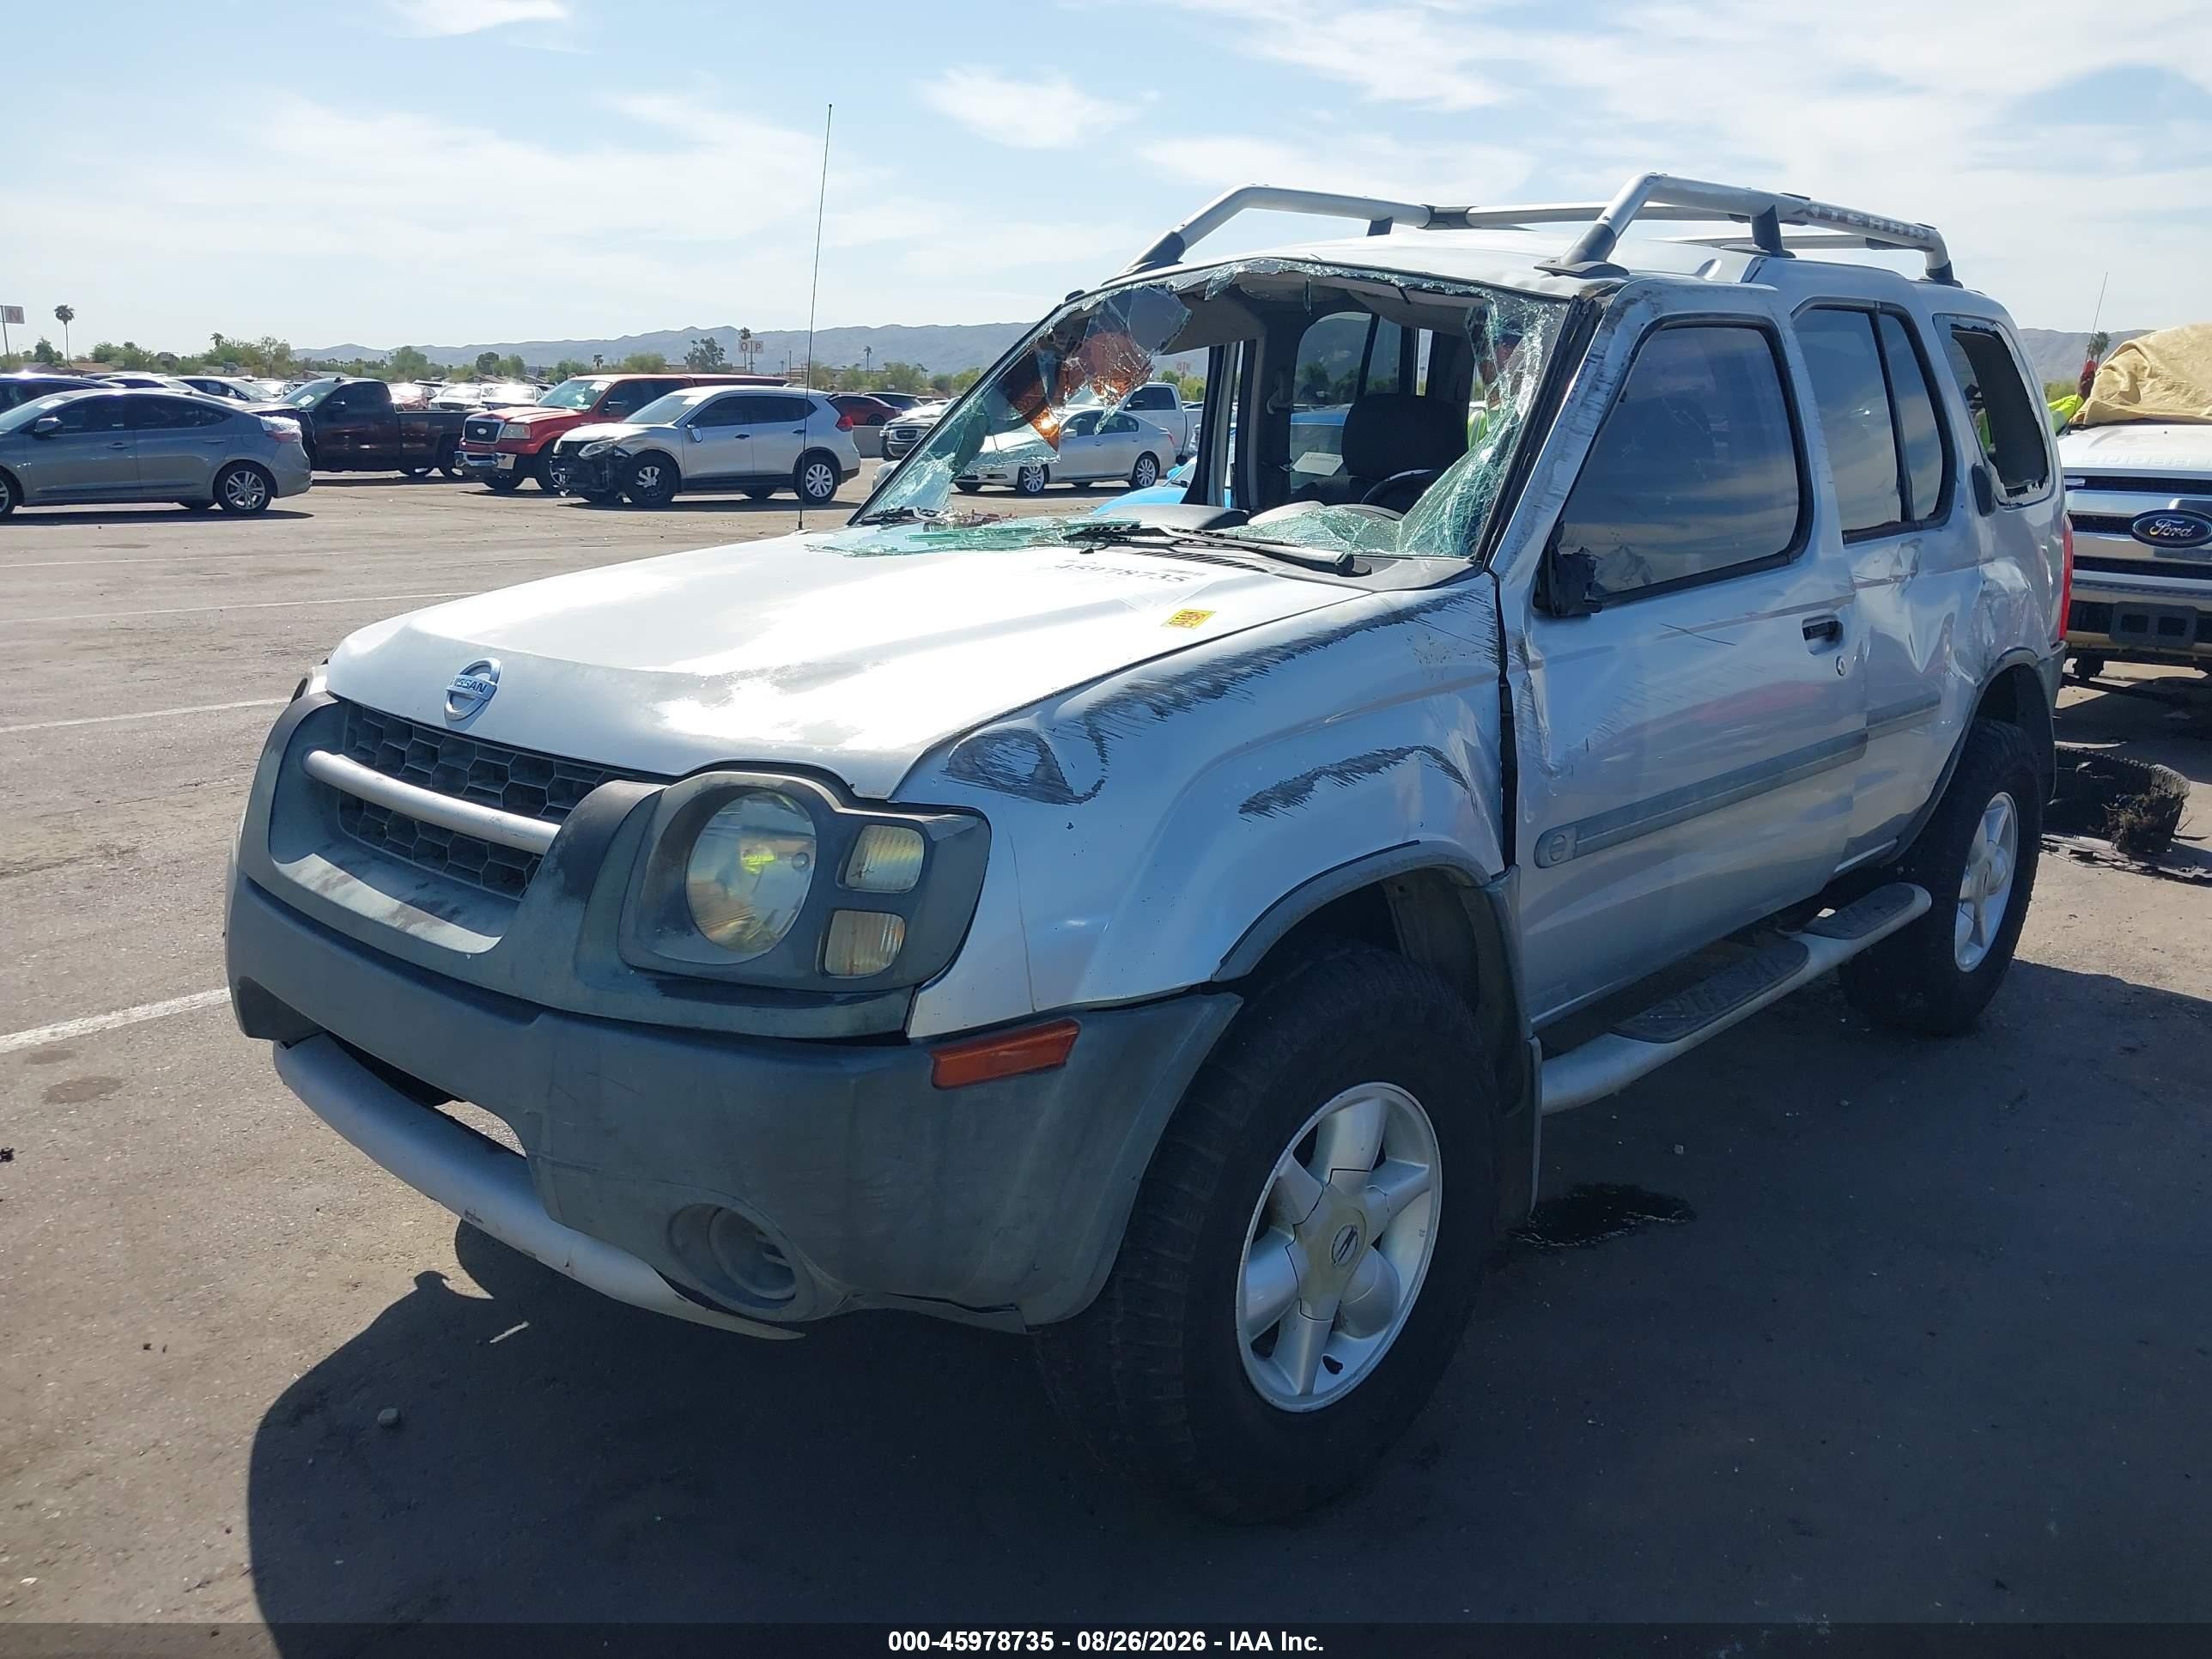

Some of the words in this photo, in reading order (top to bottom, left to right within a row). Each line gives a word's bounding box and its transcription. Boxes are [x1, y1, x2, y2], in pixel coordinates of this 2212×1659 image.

[9, 308, 21, 322] N
[755, 343, 762, 352] P
[2148, 519, 2196, 538] Ford
[449, 676, 488, 694] NISSAN
